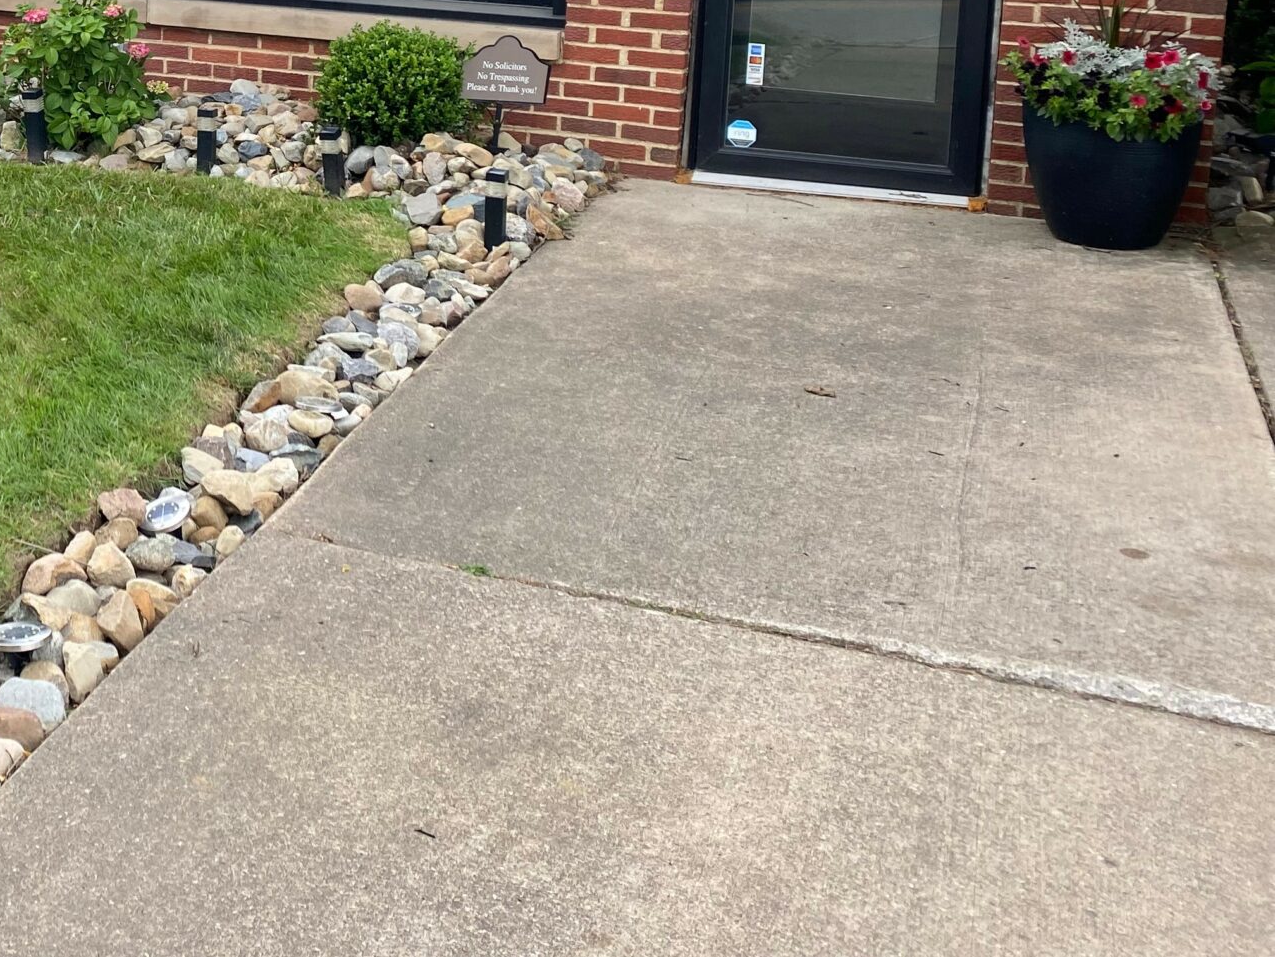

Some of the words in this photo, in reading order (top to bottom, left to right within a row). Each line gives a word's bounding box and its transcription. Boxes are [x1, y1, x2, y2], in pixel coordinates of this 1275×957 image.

[482, 61, 494, 69] No
[494, 62, 527, 71] Solicitors
[477, 72, 488, 80] No
[489, 72, 530, 84] Trespassing
[466, 82, 489, 92] Please
[489, 83, 497, 92] &
[498, 84, 520, 93] Thank
[520, 86, 538, 95] you!
